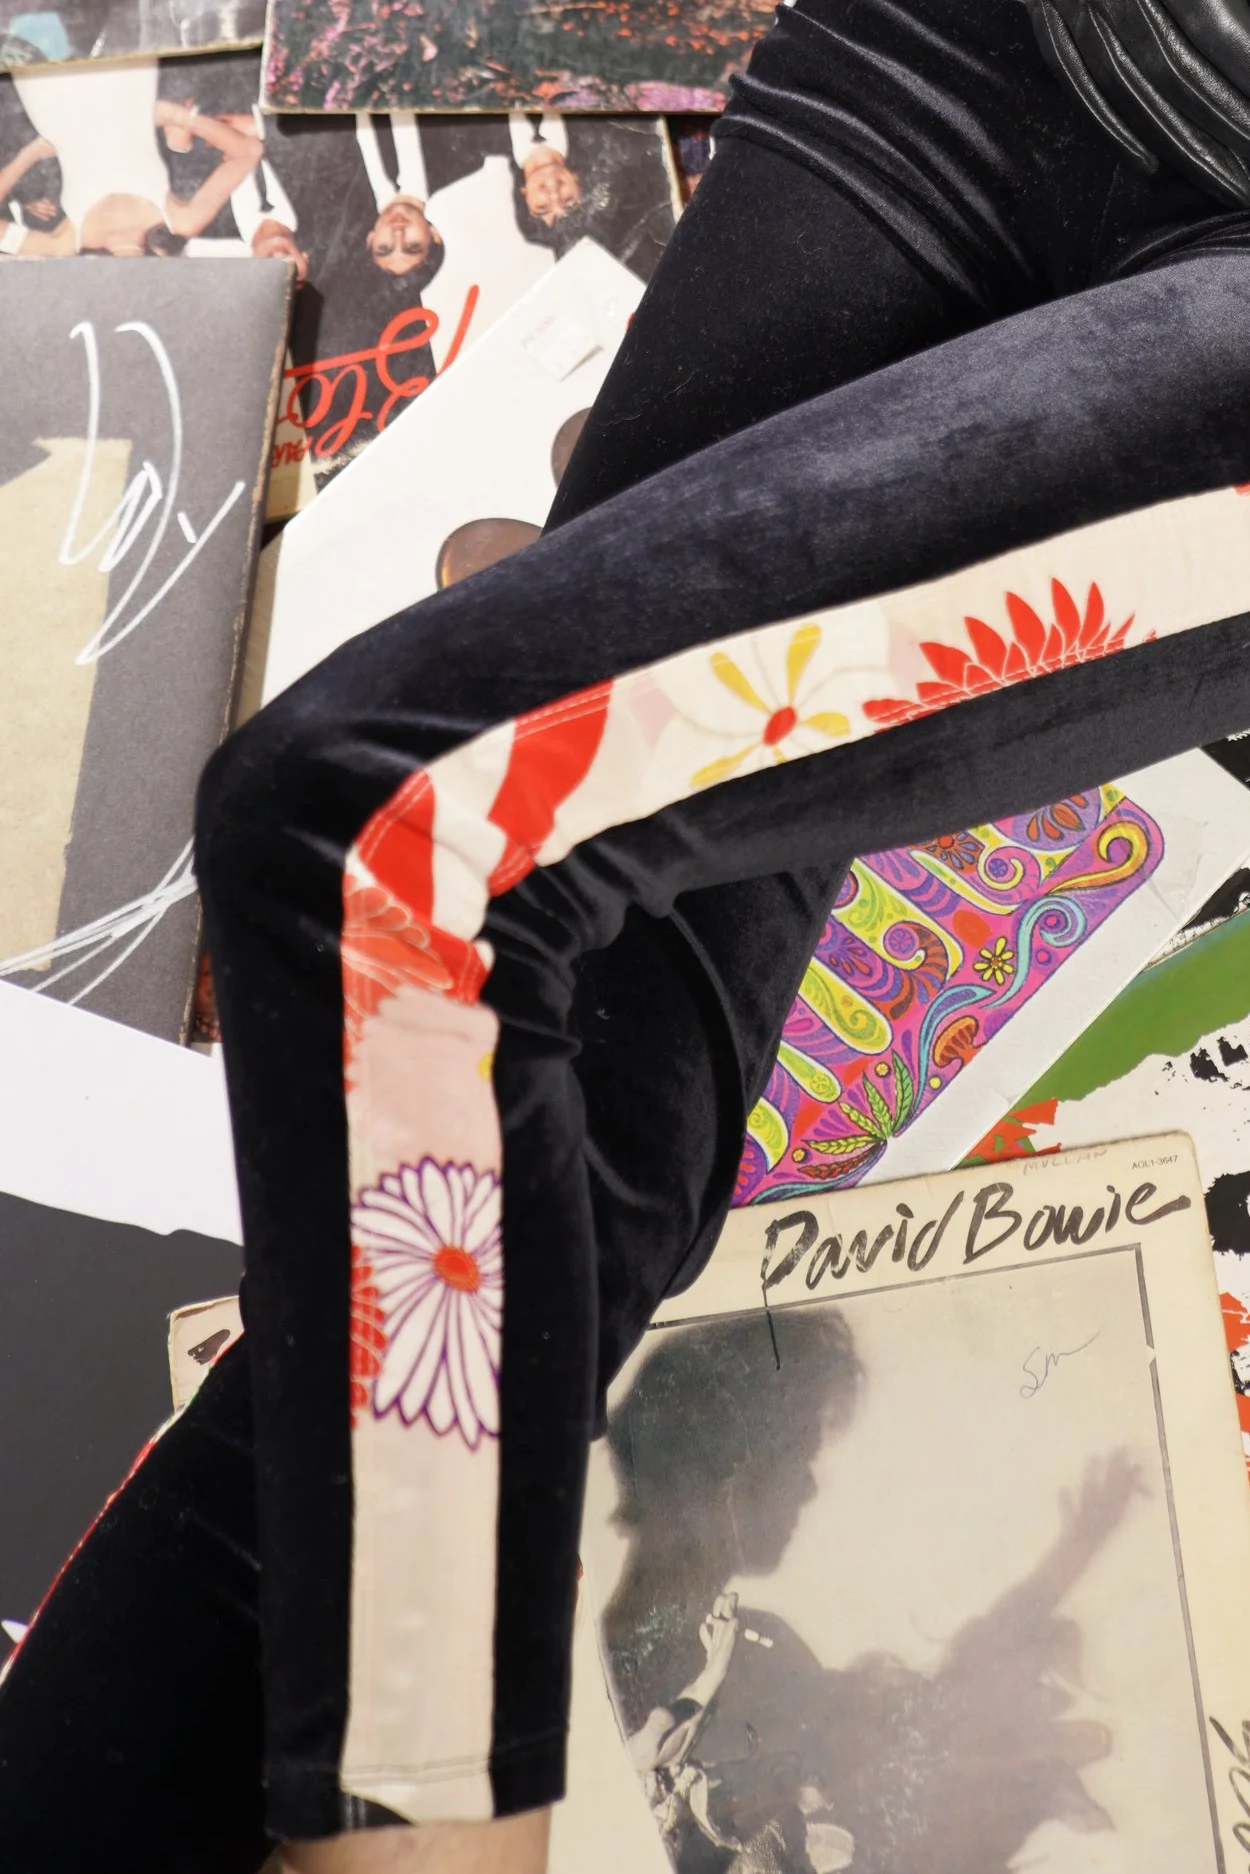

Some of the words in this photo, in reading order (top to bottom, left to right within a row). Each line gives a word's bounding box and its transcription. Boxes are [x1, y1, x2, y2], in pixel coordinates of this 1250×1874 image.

[1132, 1155, 1178, 1169] AQL1-3647
[761, 1191, 965, 1311] David
[963, 1182, 1193, 1262] Bowie
